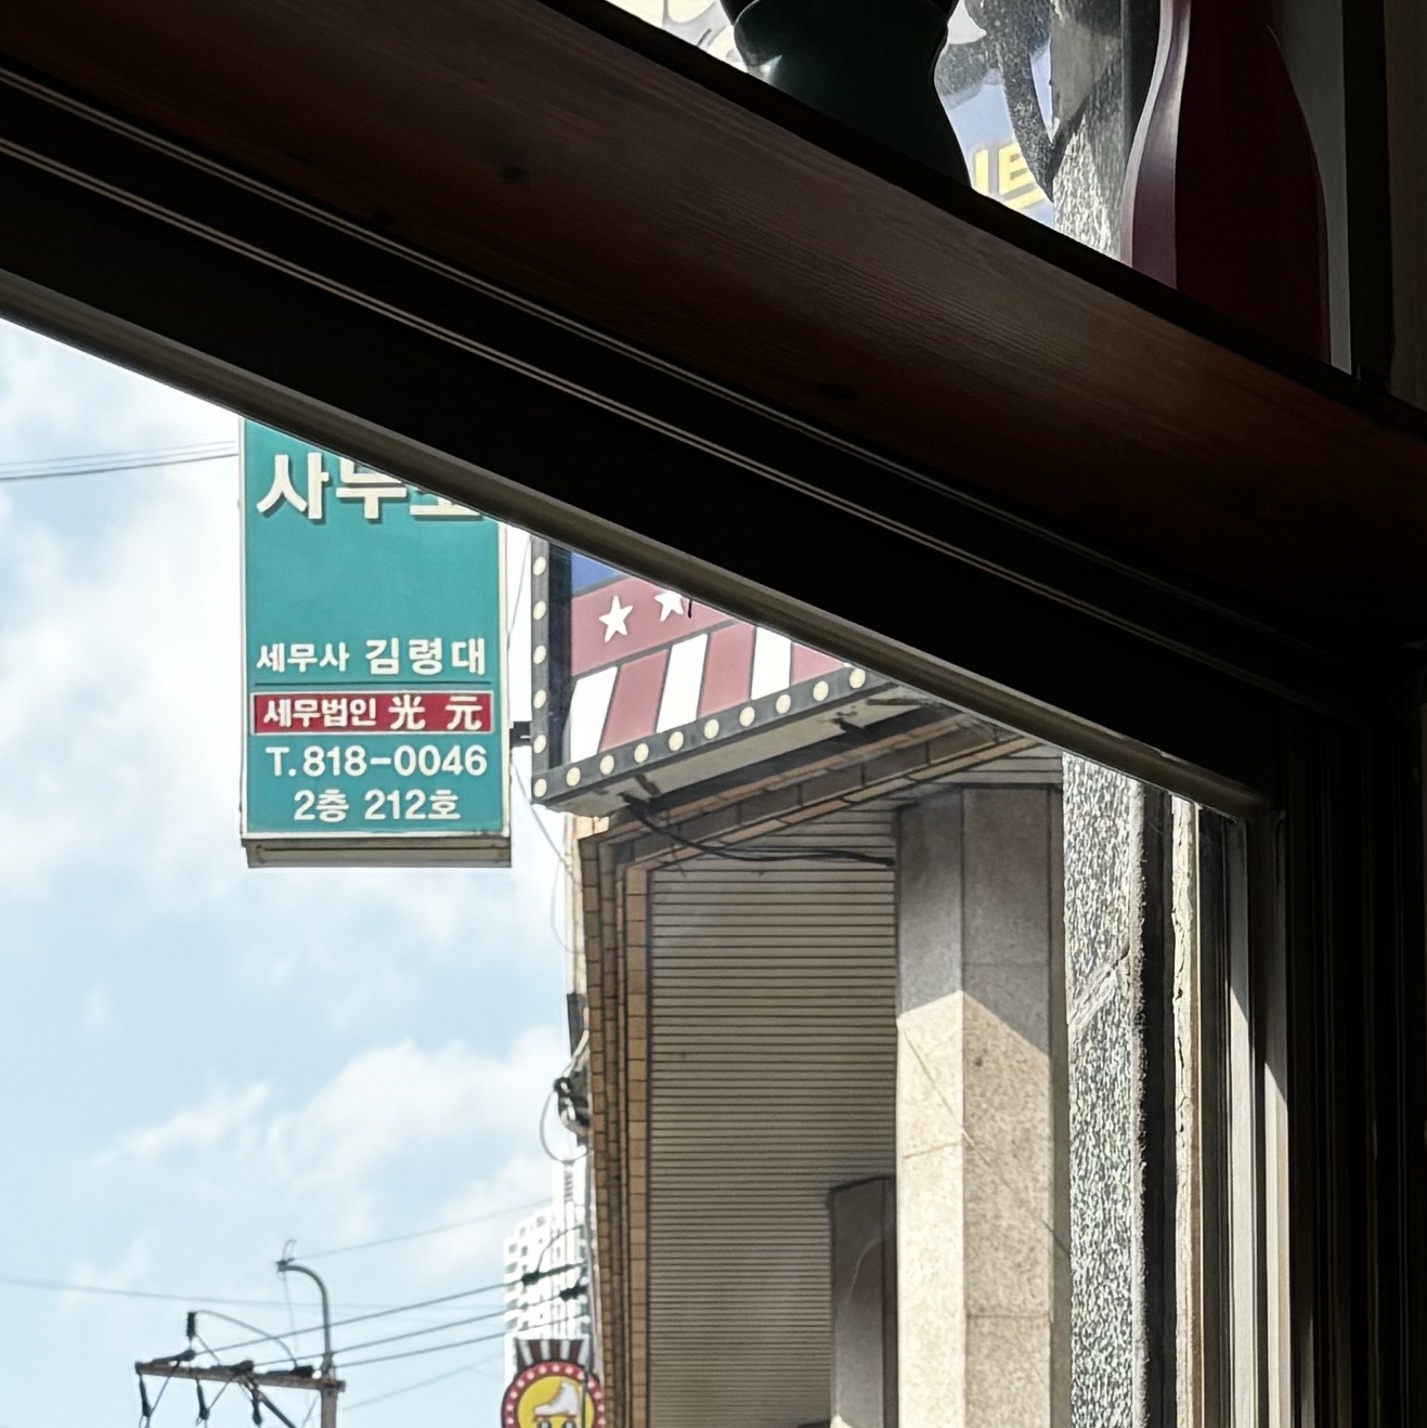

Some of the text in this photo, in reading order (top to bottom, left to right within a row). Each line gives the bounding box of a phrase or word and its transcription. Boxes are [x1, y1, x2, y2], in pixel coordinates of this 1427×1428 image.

[256, 638, 486, 678] 세무사 김령대
[263, 699, 378, 728] 세무법인
[266, 746, 488, 779] T.818-0046
[293, 790, 462, 824] 2층 212호
